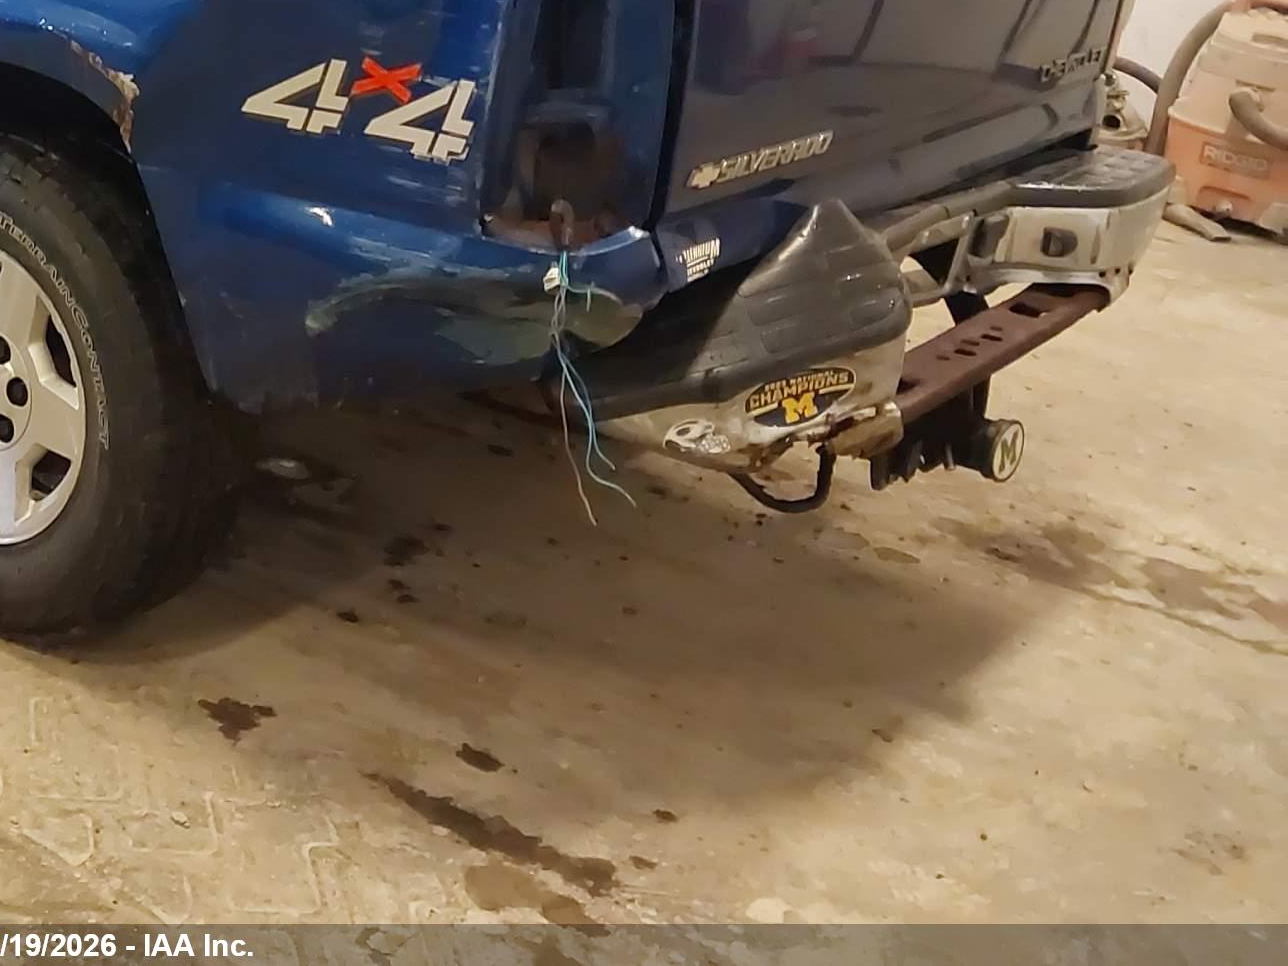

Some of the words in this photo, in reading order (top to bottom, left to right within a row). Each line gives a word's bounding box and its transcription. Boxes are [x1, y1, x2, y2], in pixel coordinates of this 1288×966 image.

[715, 130, 834, 184] SILVERADO
[749, 372, 849, 410] CHAMPIONS
[782, 392, 818, 425] M
